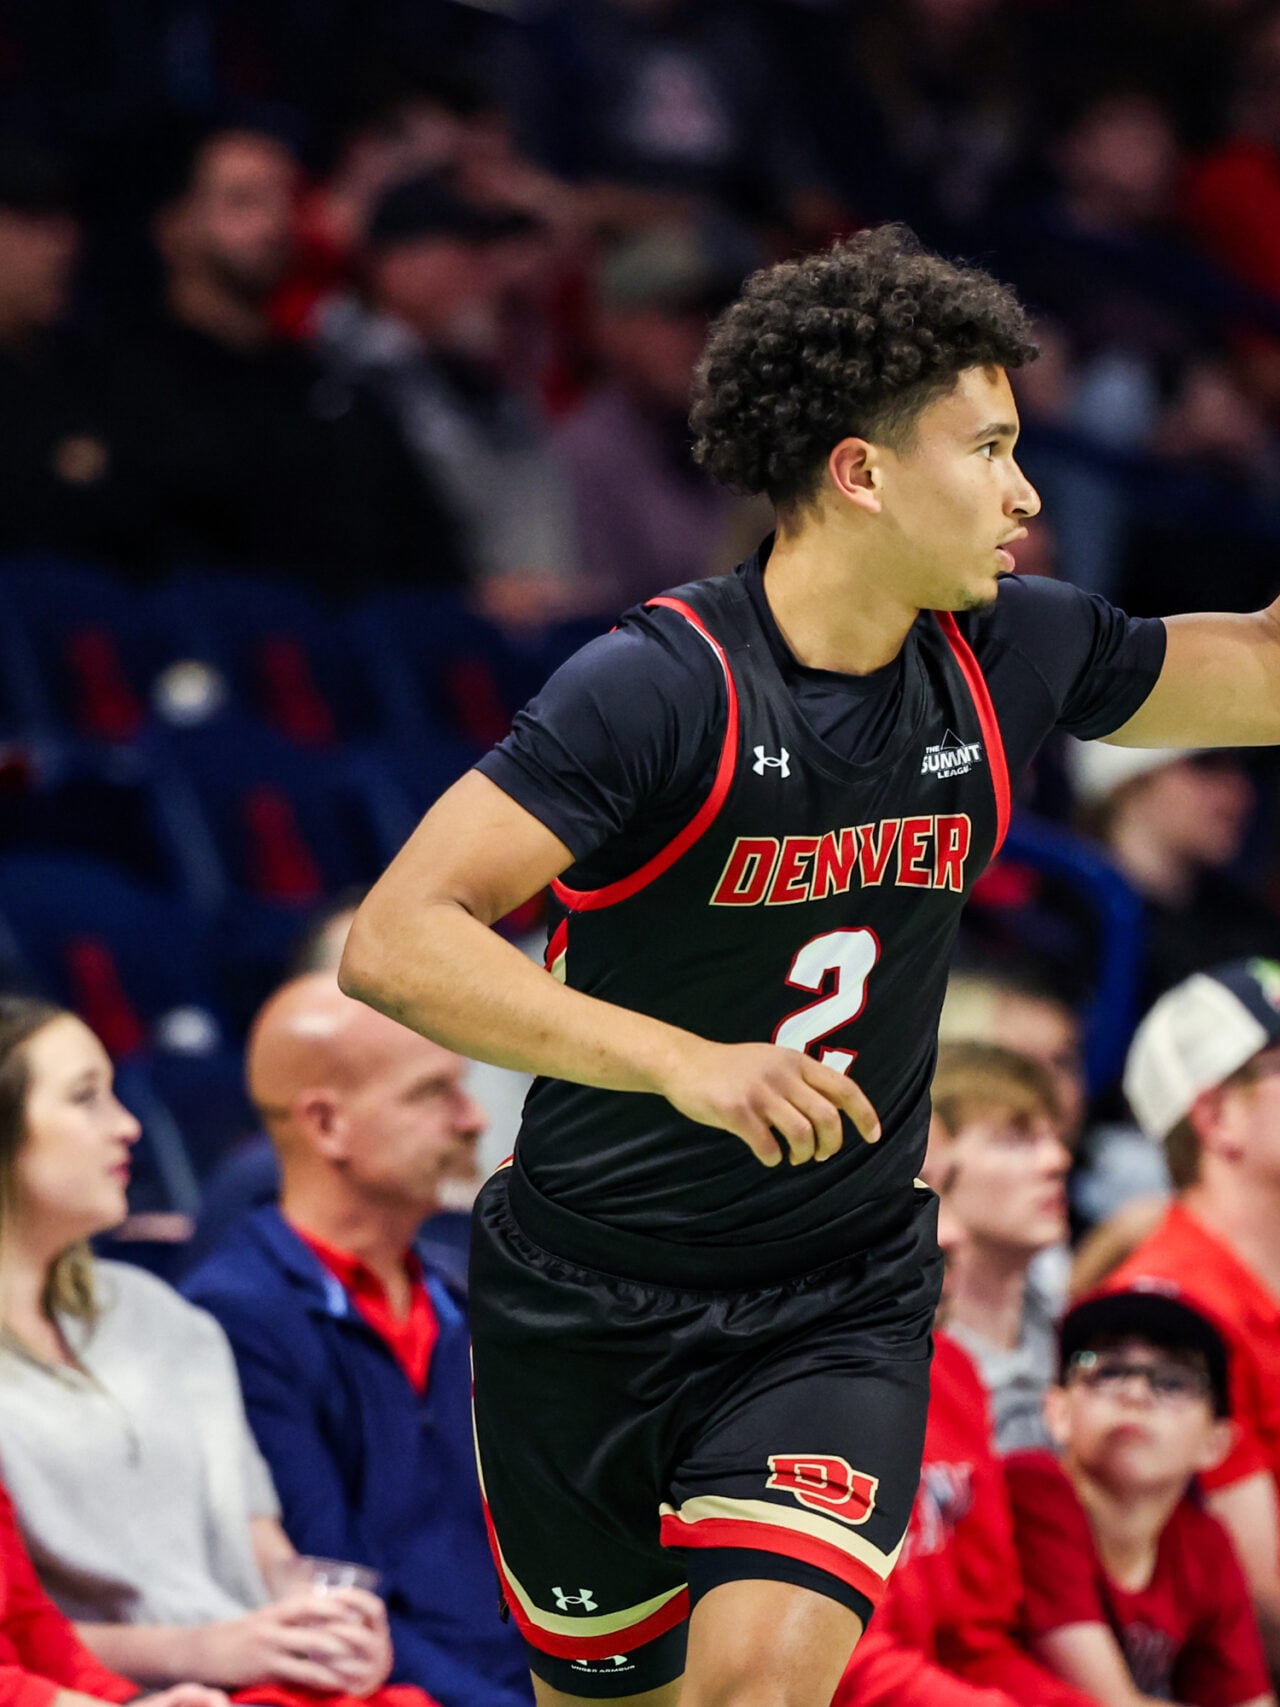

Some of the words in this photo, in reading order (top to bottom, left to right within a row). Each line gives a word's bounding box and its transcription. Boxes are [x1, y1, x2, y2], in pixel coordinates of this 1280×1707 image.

[925, 745, 940, 754] THE
[709, 812, 971, 906] DENVER
[771, 926, 881, 1075] 2
[765, 1454, 879, 1525] DU
[570, 1664, 598, 1673] UNDER
[599, 1664, 636, 1673] ARMOUR
